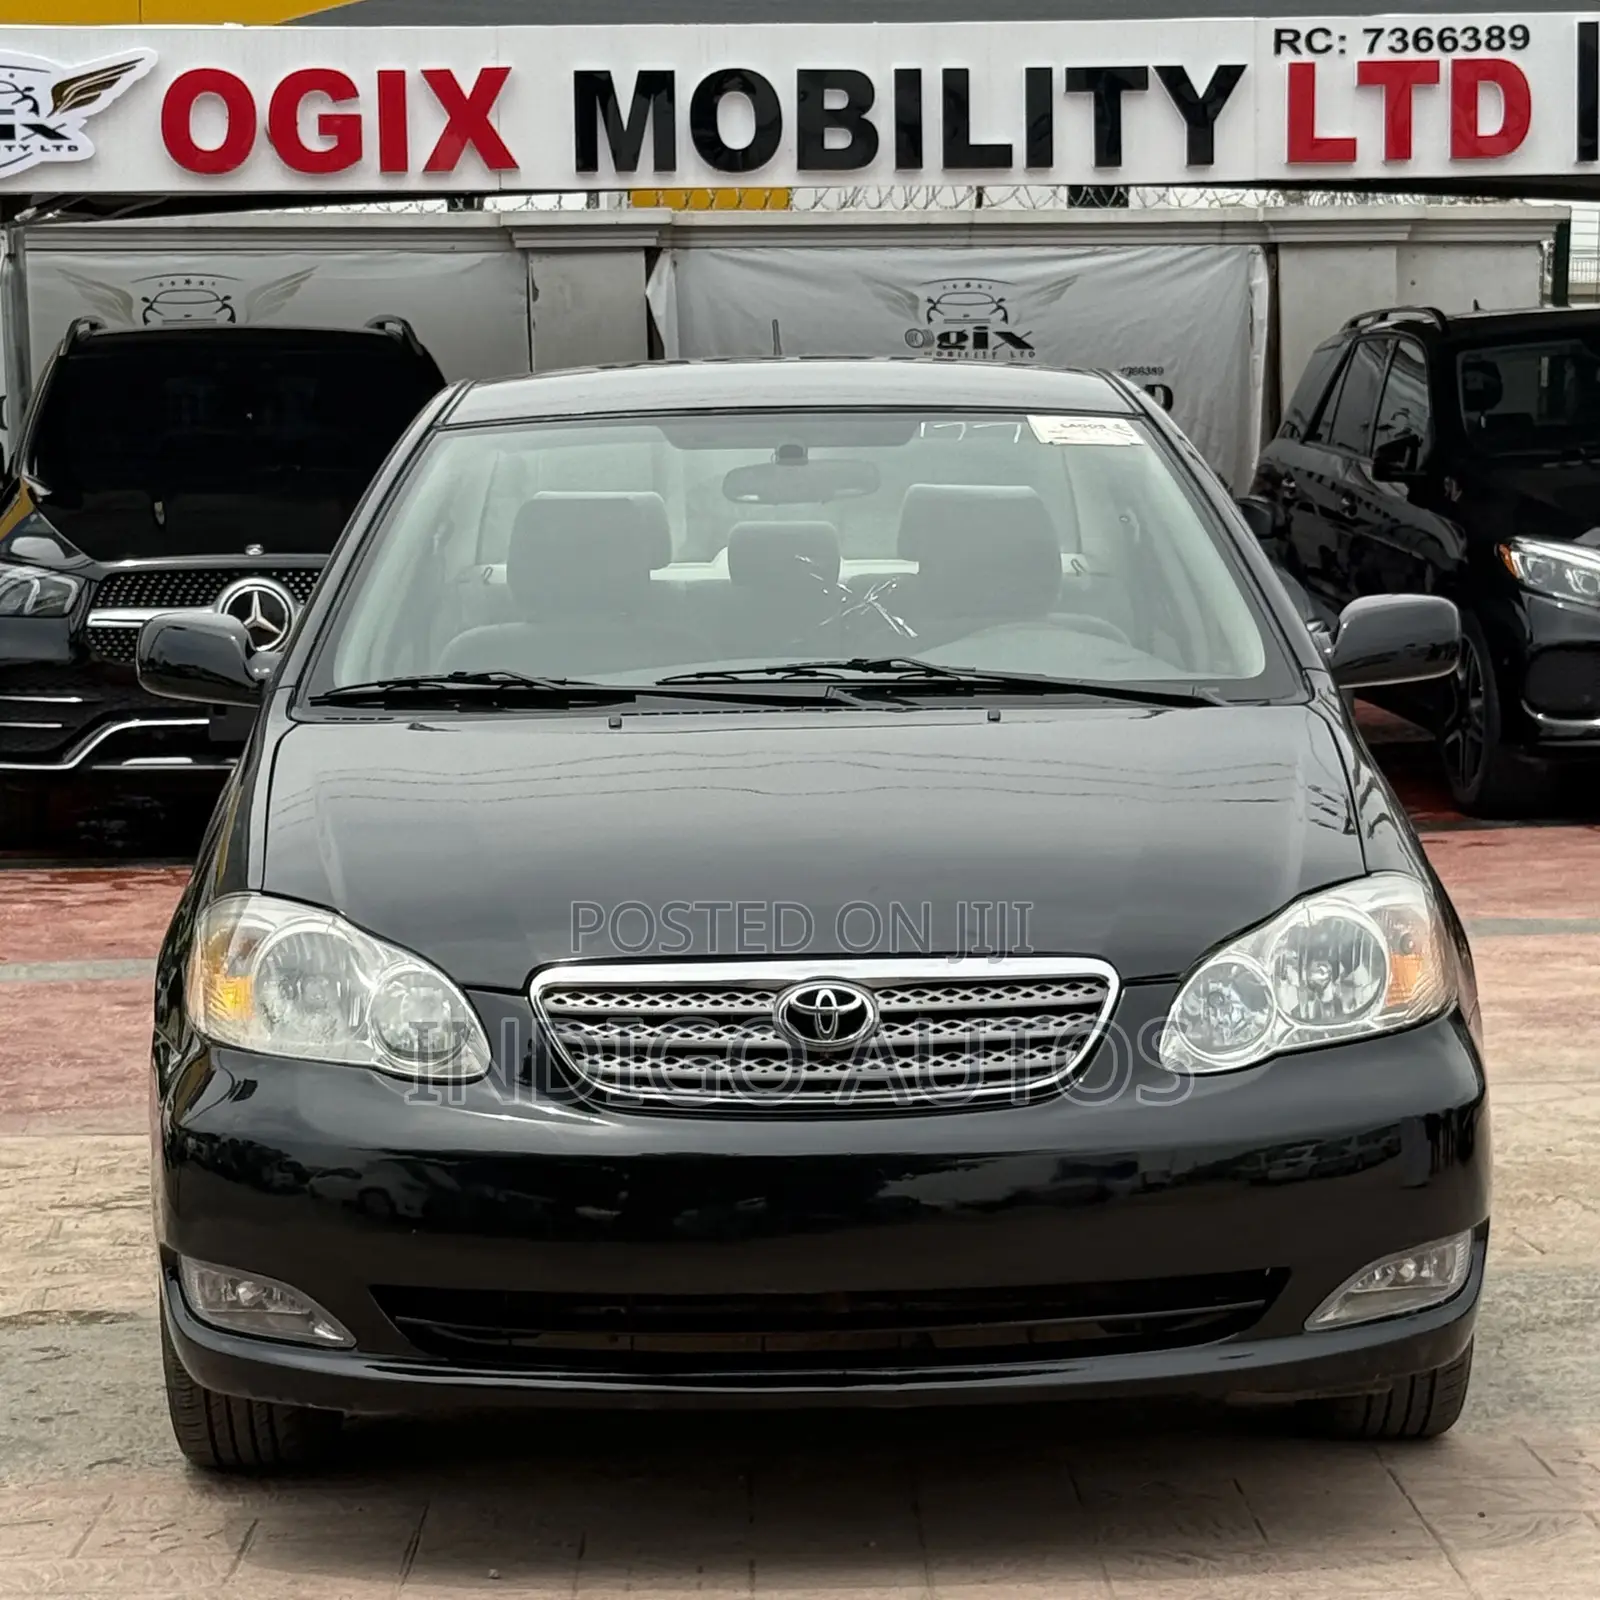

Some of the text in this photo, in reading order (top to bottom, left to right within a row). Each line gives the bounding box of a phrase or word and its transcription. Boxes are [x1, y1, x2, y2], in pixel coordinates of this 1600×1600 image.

[1272, 24, 1531, 56] RC: 7366389
[160, 57, 1533, 175] OGIX MOBILITY LTD
